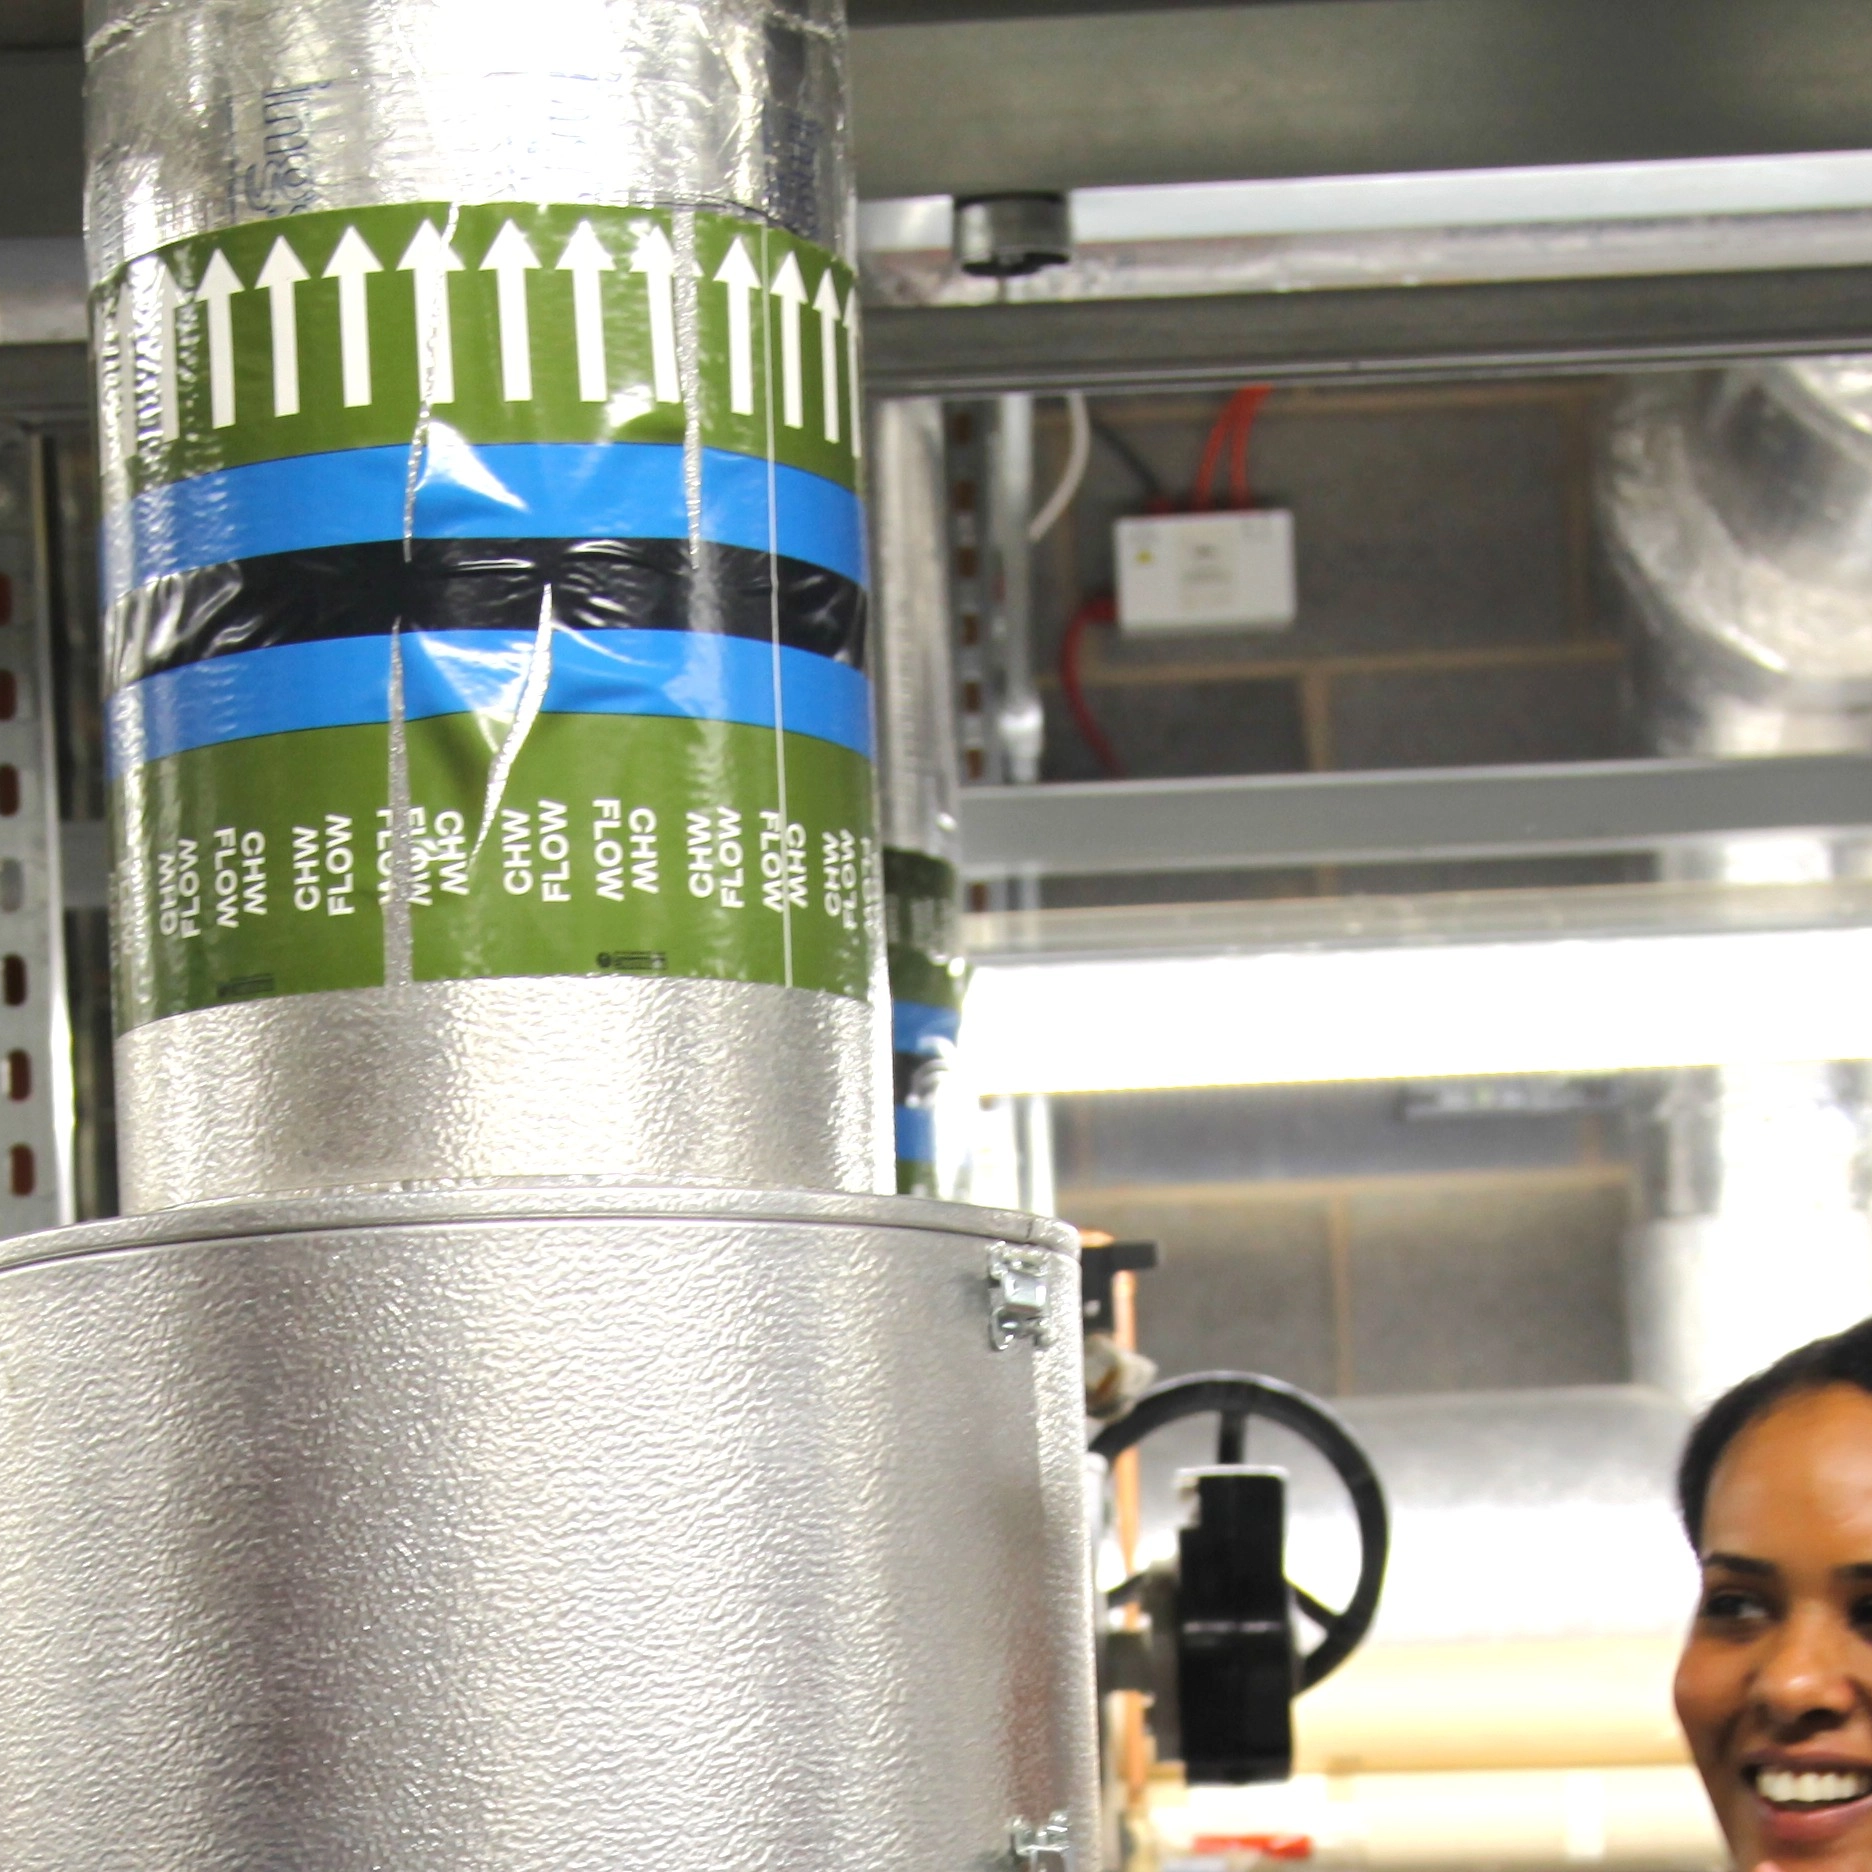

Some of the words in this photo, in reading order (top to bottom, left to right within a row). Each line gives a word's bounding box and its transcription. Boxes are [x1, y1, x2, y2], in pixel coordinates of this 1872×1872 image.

[159, 853, 179, 936] CHW
[178, 838, 202, 939] FLOW
[213, 827, 240, 929] FLOW
[240, 830, 268, 916] CHW
[292, 826, 322, 912] CHW
[325, 813, 356, 917] FLOW
[434, 810, 471, 896] CHW
[501, 808, 534, 896] CHW
[538, 799, 572, 903] FLOW
[592, 799, 626, 903] FLOW
[629, 807, 660, 895] CHW
[686, 811, 715, 899] CHW
[716, 805, 746, 909] FLOW
[759, 810, 785, 914] FLOW
[785, 823, 809, 909] CHW
[821, 831, 842, 918] CHW
[840, 828, 859, 931] FLOW
